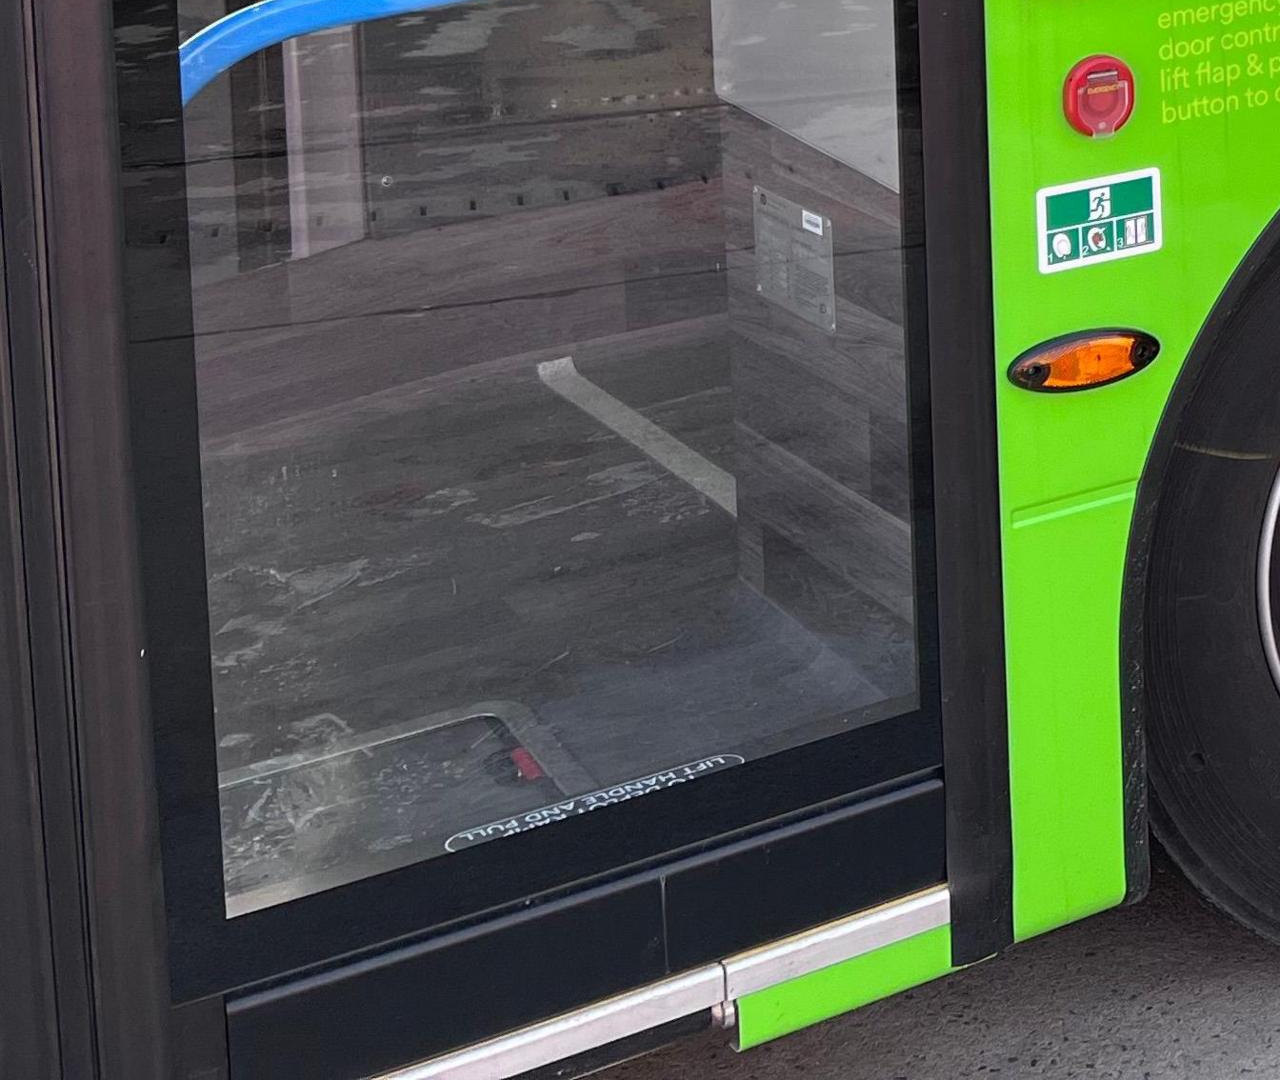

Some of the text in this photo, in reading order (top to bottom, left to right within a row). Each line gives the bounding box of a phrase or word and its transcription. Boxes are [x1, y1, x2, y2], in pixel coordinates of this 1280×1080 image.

[1158, 35, 1214, 61] door
[1160, 68, 1190, 92] lift
[1196, 60, 1241, 88] flap
[1246, 53, 1264, 77] &
[1161, 93, 1239, 124] button
[1245, 89, 1268, 108] to
[459, 756, 727, 842] LIFT HANDLE AND PULL
